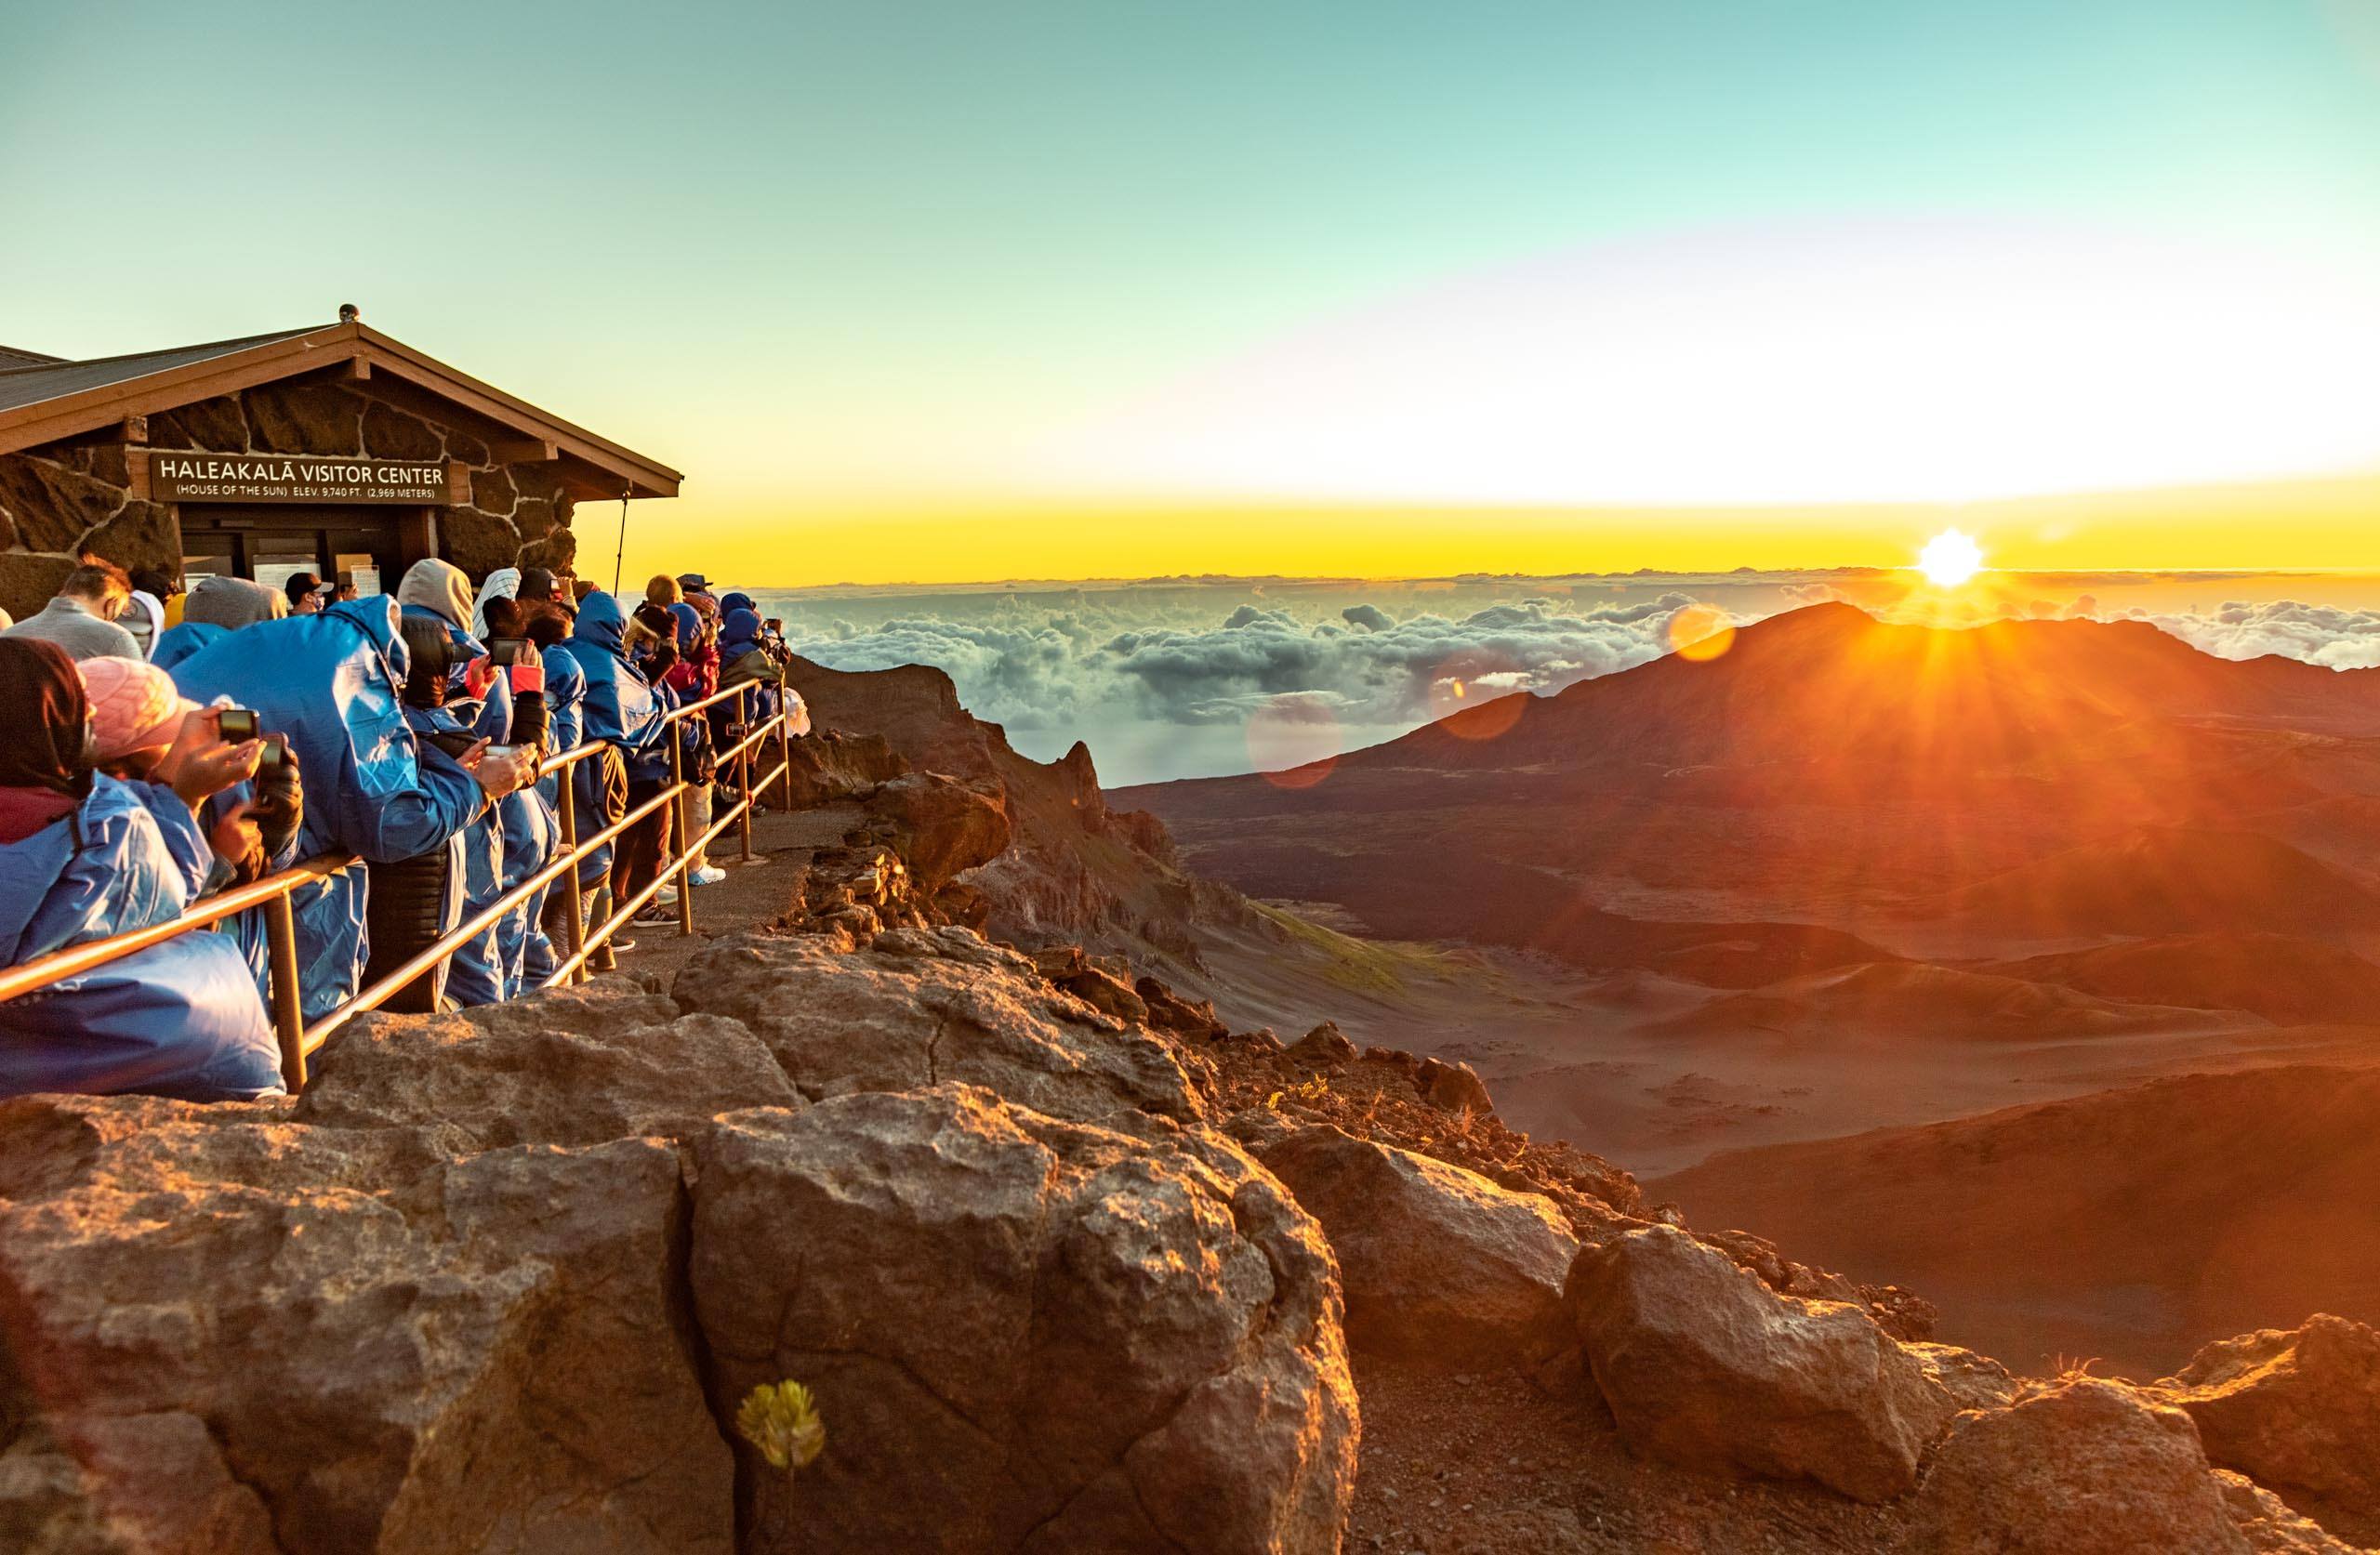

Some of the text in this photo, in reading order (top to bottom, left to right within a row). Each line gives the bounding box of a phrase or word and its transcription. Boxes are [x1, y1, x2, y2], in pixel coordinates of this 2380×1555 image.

[161, 460, 443, 484] HALEAKALĀ VISITOR CENTER
[177, 483, 434, 498] (HOUSE OF THE SUN) ELEV. 9,740 FT. (2,969 METERS)
